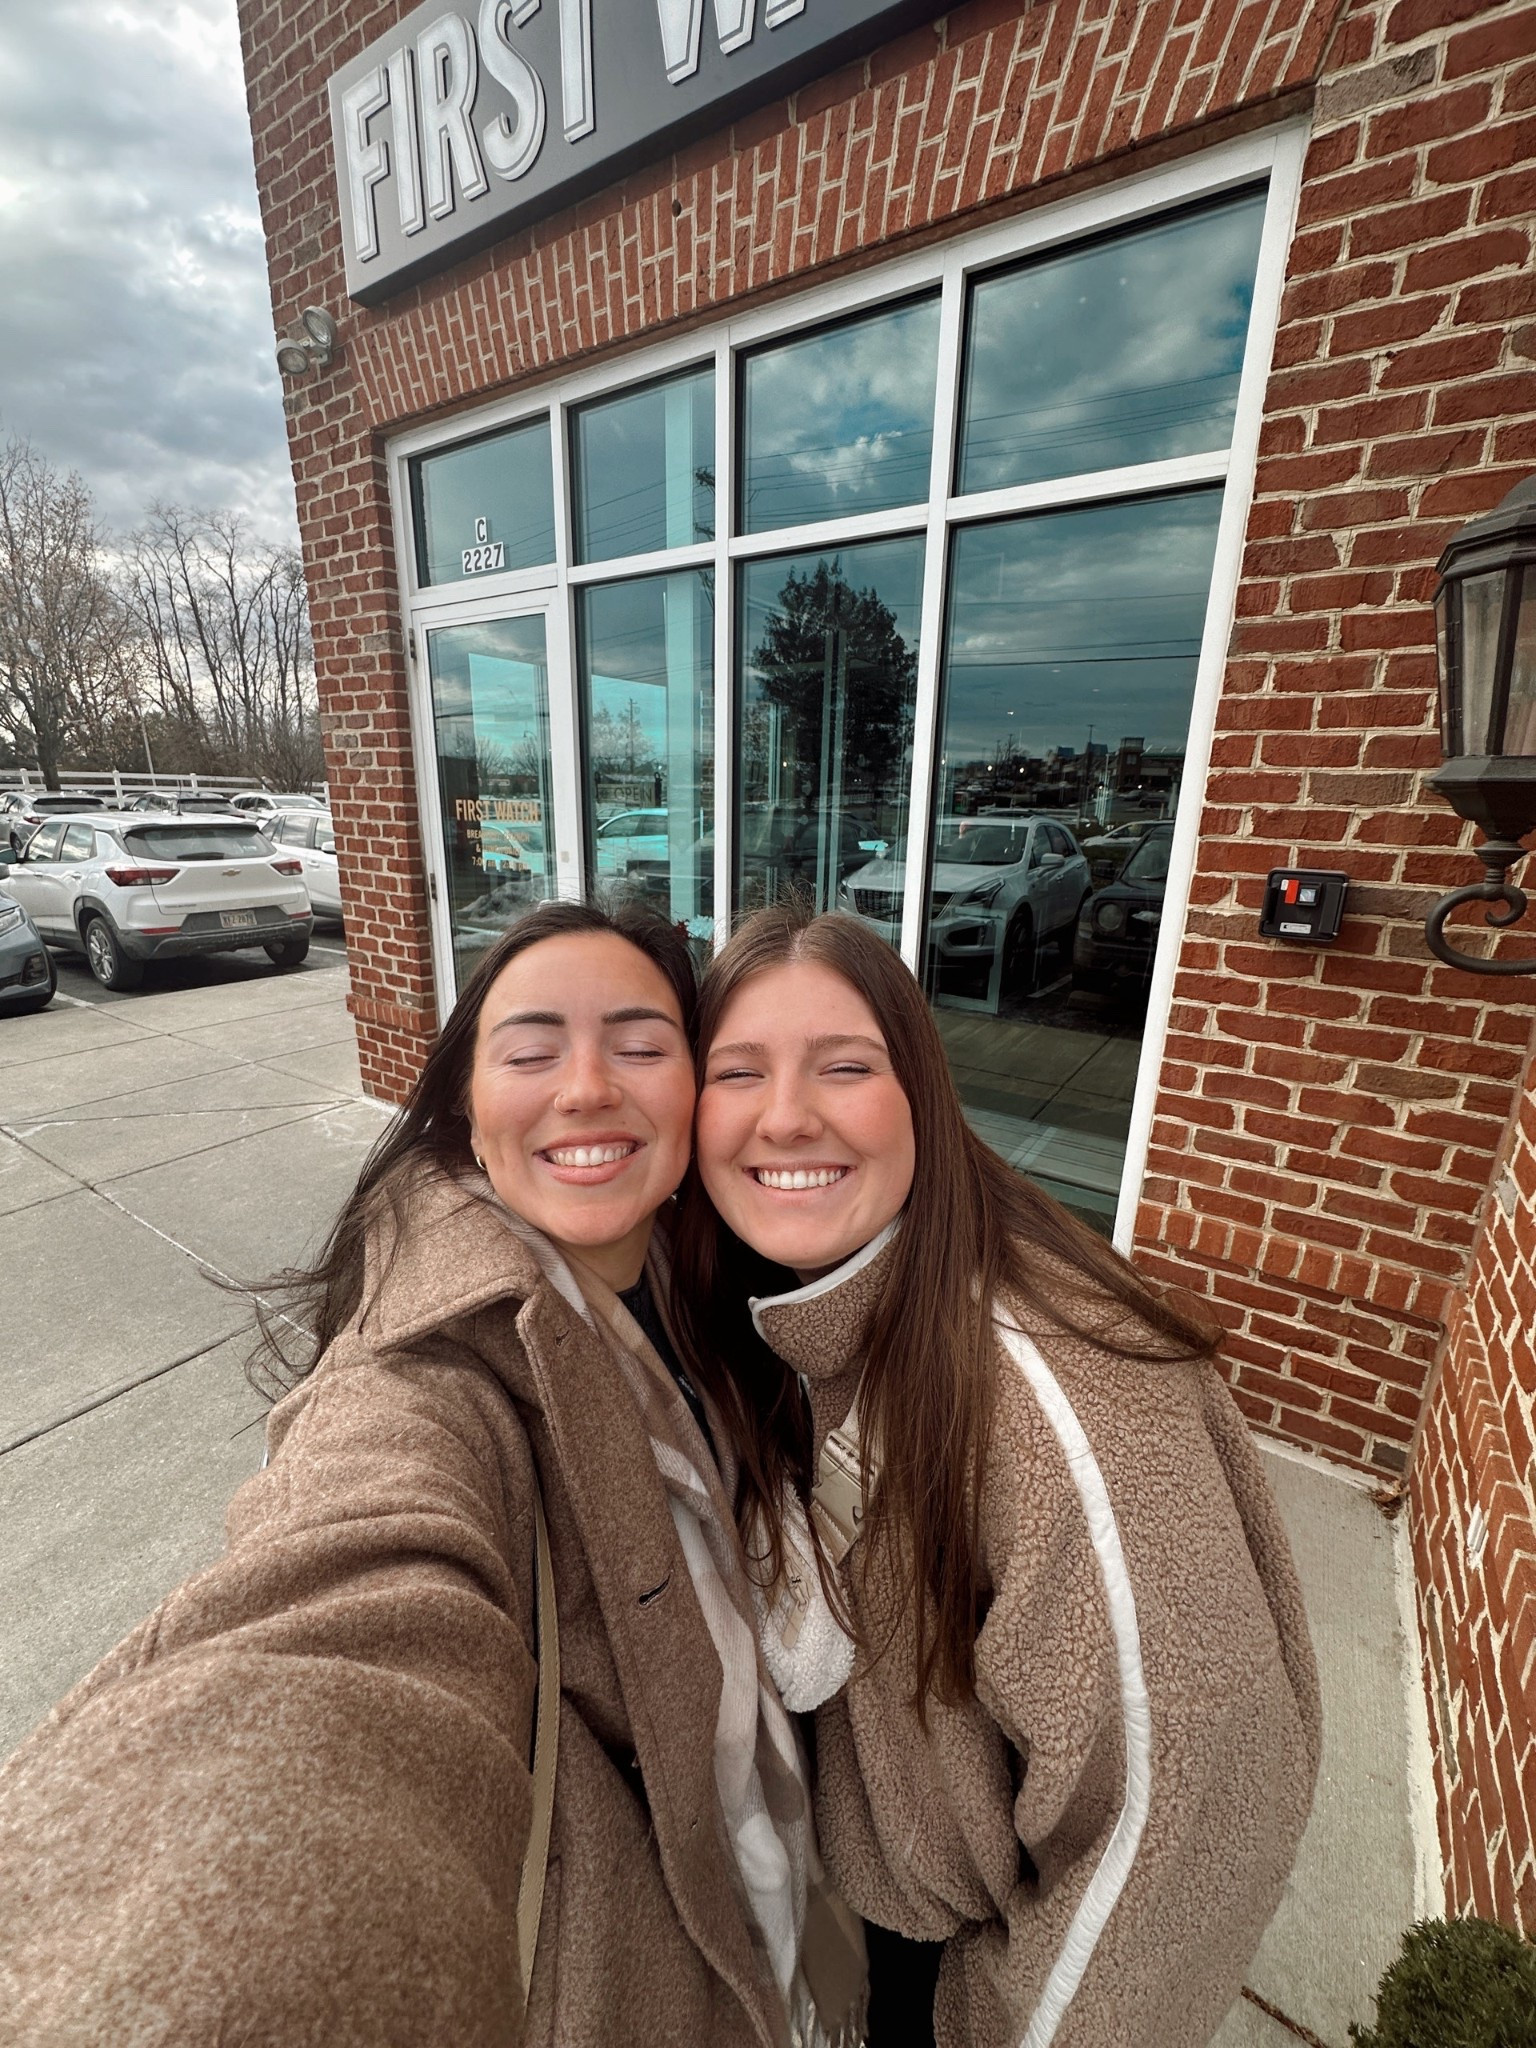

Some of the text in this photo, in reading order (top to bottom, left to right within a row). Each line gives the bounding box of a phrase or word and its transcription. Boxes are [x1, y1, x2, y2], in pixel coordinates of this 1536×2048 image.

[477, 519, 486, 541] C
[464, 544, 502, 572] 2227
[614, 786, 652, 802] OPEN
[455, 799, 539, 823] FIRST WATCH
